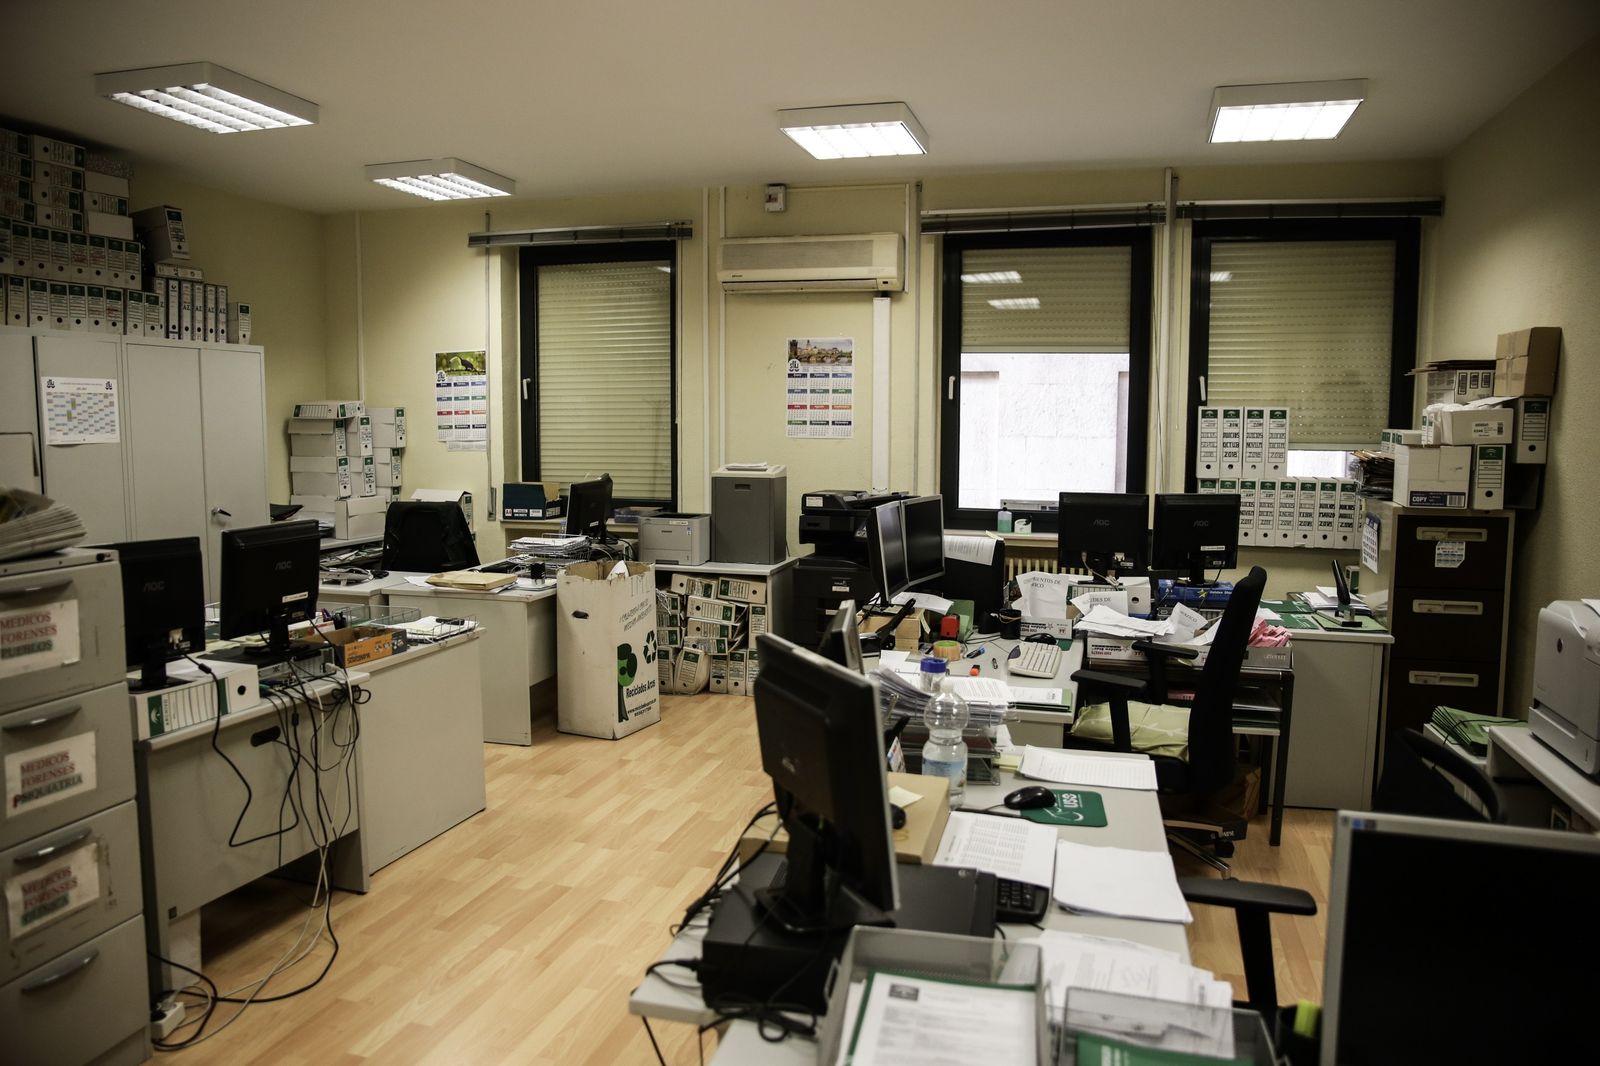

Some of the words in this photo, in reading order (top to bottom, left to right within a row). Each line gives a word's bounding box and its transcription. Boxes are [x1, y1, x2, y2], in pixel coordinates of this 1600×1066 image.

[275, 560, 293, 571] AOC
[143, 581, 165, 592] AOC
[1, 625, 57, 643] FORENSES
[22, 763, 75, 788] FORENSES
[24, 877, 78, 910] FORENSES
